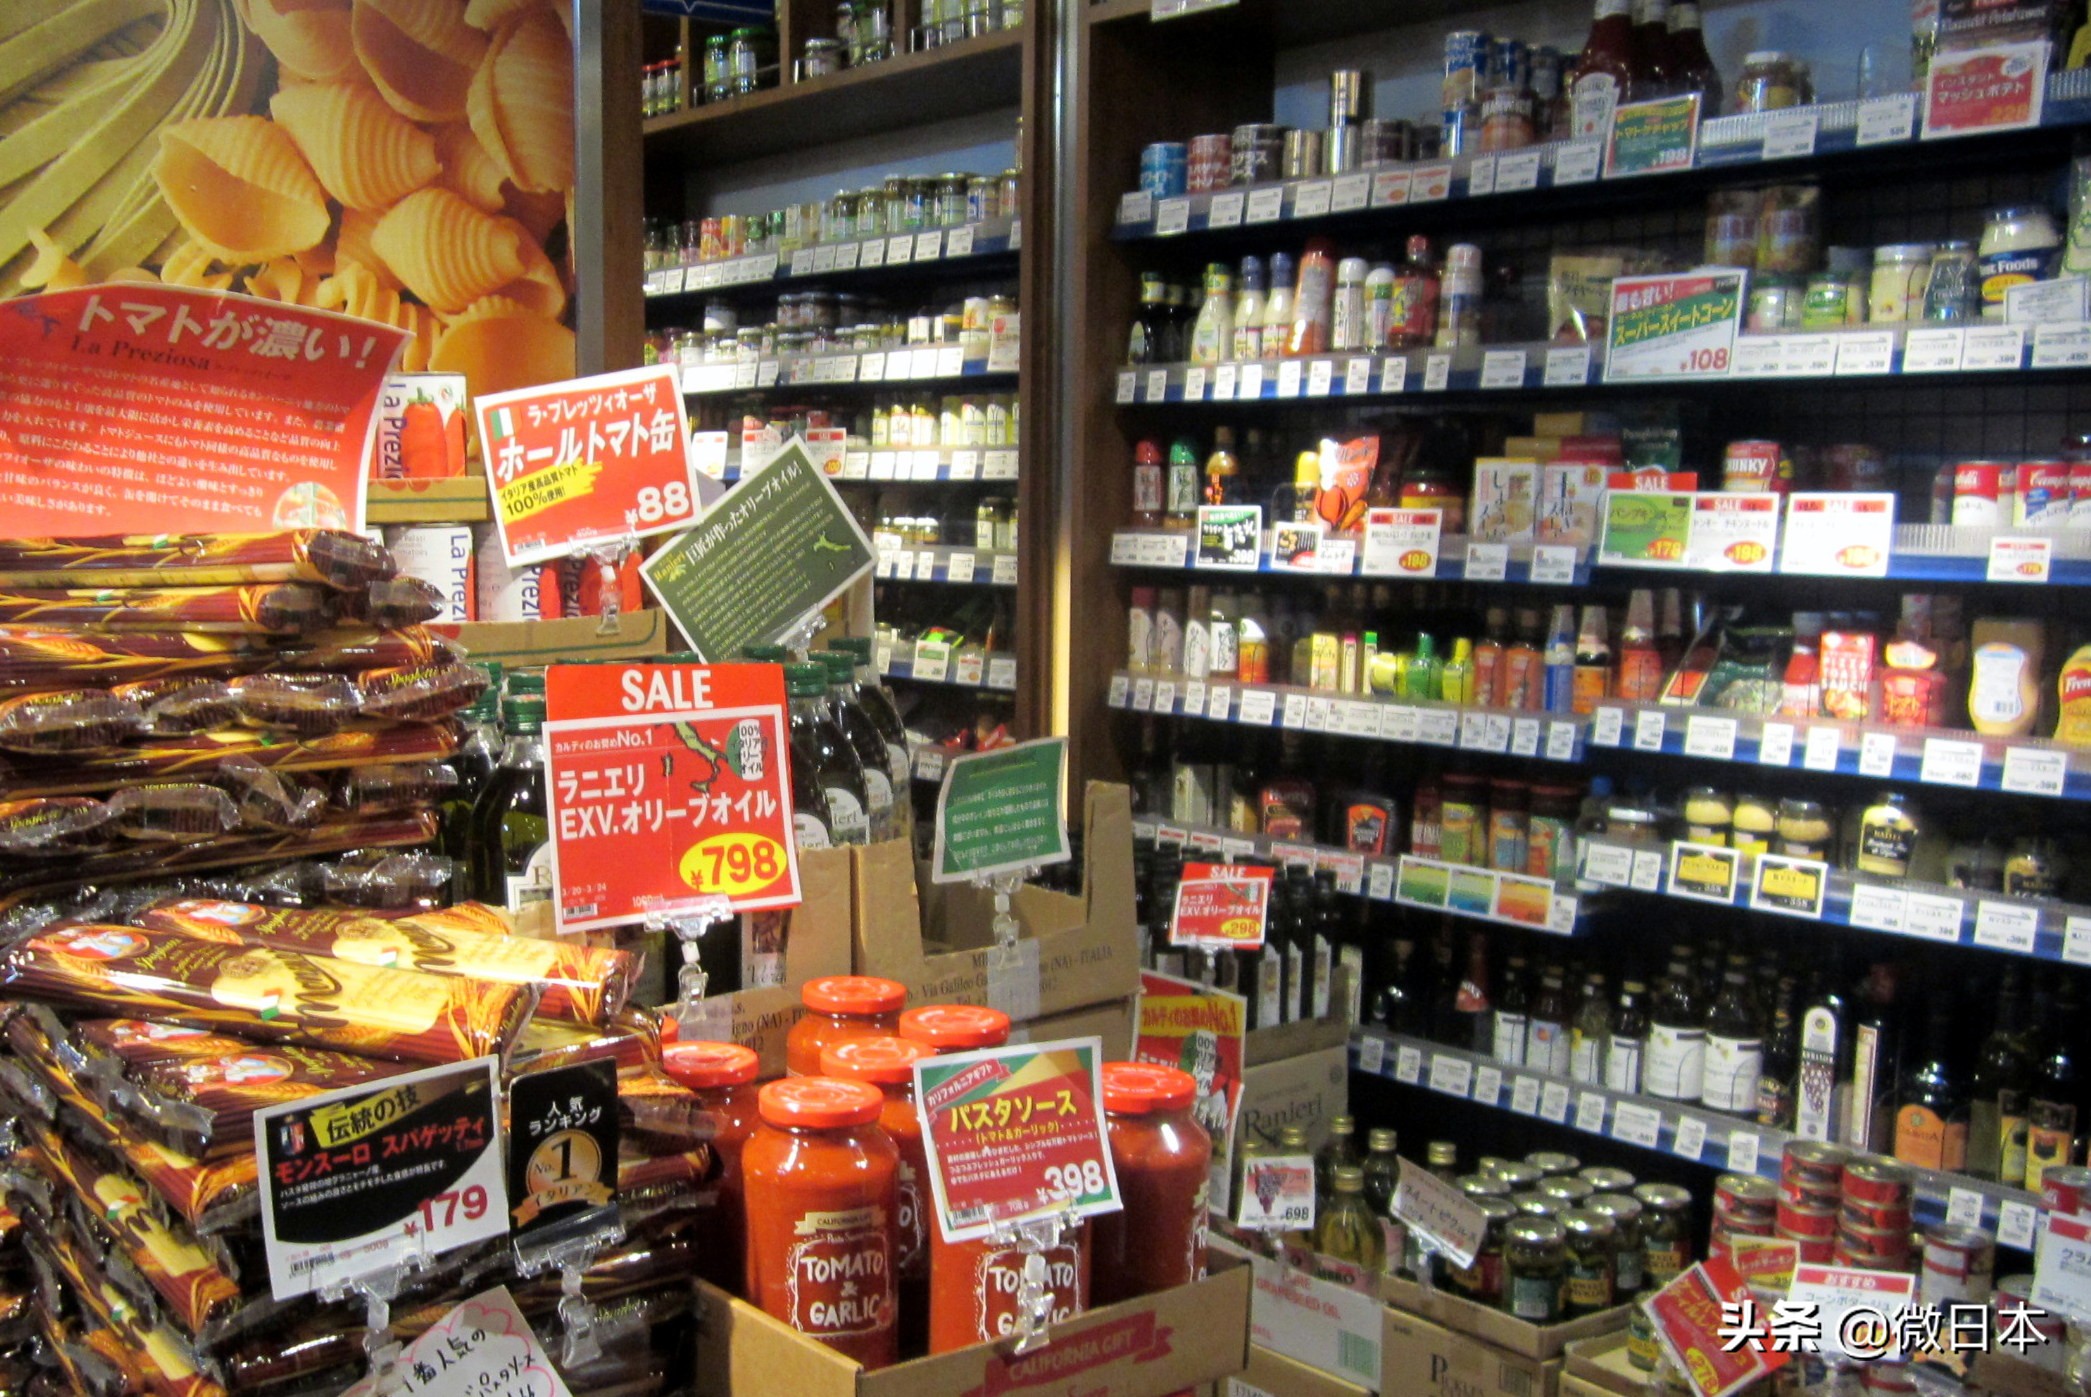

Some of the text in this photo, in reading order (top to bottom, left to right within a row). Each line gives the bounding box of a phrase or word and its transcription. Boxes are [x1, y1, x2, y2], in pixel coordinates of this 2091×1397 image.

[77, 293, 378, 370] トマトが濃い!
[1614, 297, 1735, 348] スーパースイートコーン
[112, 338, 211, 372] Preziosa
[496, 407, 677, 482] ホールトマト缶
[500, 463, 579, 502] イタリア産高品質トマト
[505, 486, 567, 518] 100%使用!
[624, 481, 690, 526] ¥88
[1634, 475, 1670, 490] SALE
[685, 459, 804, 567] 巨匠が作ったオリーブオイル!
[1713, 499, 1742, 512] SALE
[450, 533, 469, 559] La
[621, 668, 714, 711] SALE
[557, 762, 645, 807] ラニエリ
[559, 789, 777, 841] EXV.オリーブオイル
[689, 839, 780, 891] ¥798
[1209, 865, 1247, 879] SALE
[757, 1013, 783, 1031] (NA)
[547, 1095, 584, 1118] 人気
[926, 1062, 994, 1108] カリフォルニアギフト
[326, 1083, 420, 1145] 伝統の技
[528, 1104, 603, 1137] ランキング
[950, 1089, 1078, 1134] パスタソース
[975, 1120, 1061, 1146] (トマト&ガーリック)
[1242, 1095, 1323, 1139] Ranieri
[274, 1115, 486, 1185] モンスーロ スパゲッティ
[550, 1137, 578, 1181] 1
[1035, 1158, 1105, 1206] ¥398
[402, 1183, 489, 1239] ¥179
[799, 1250, 884, 1283] TOMATO
[1825, 1272, 1877, 1289] おすすめ
[809, 1293, 880, 1329] GARLIC
[1008, 1328, 1134, 1382] CALIFORNIA GIFT
